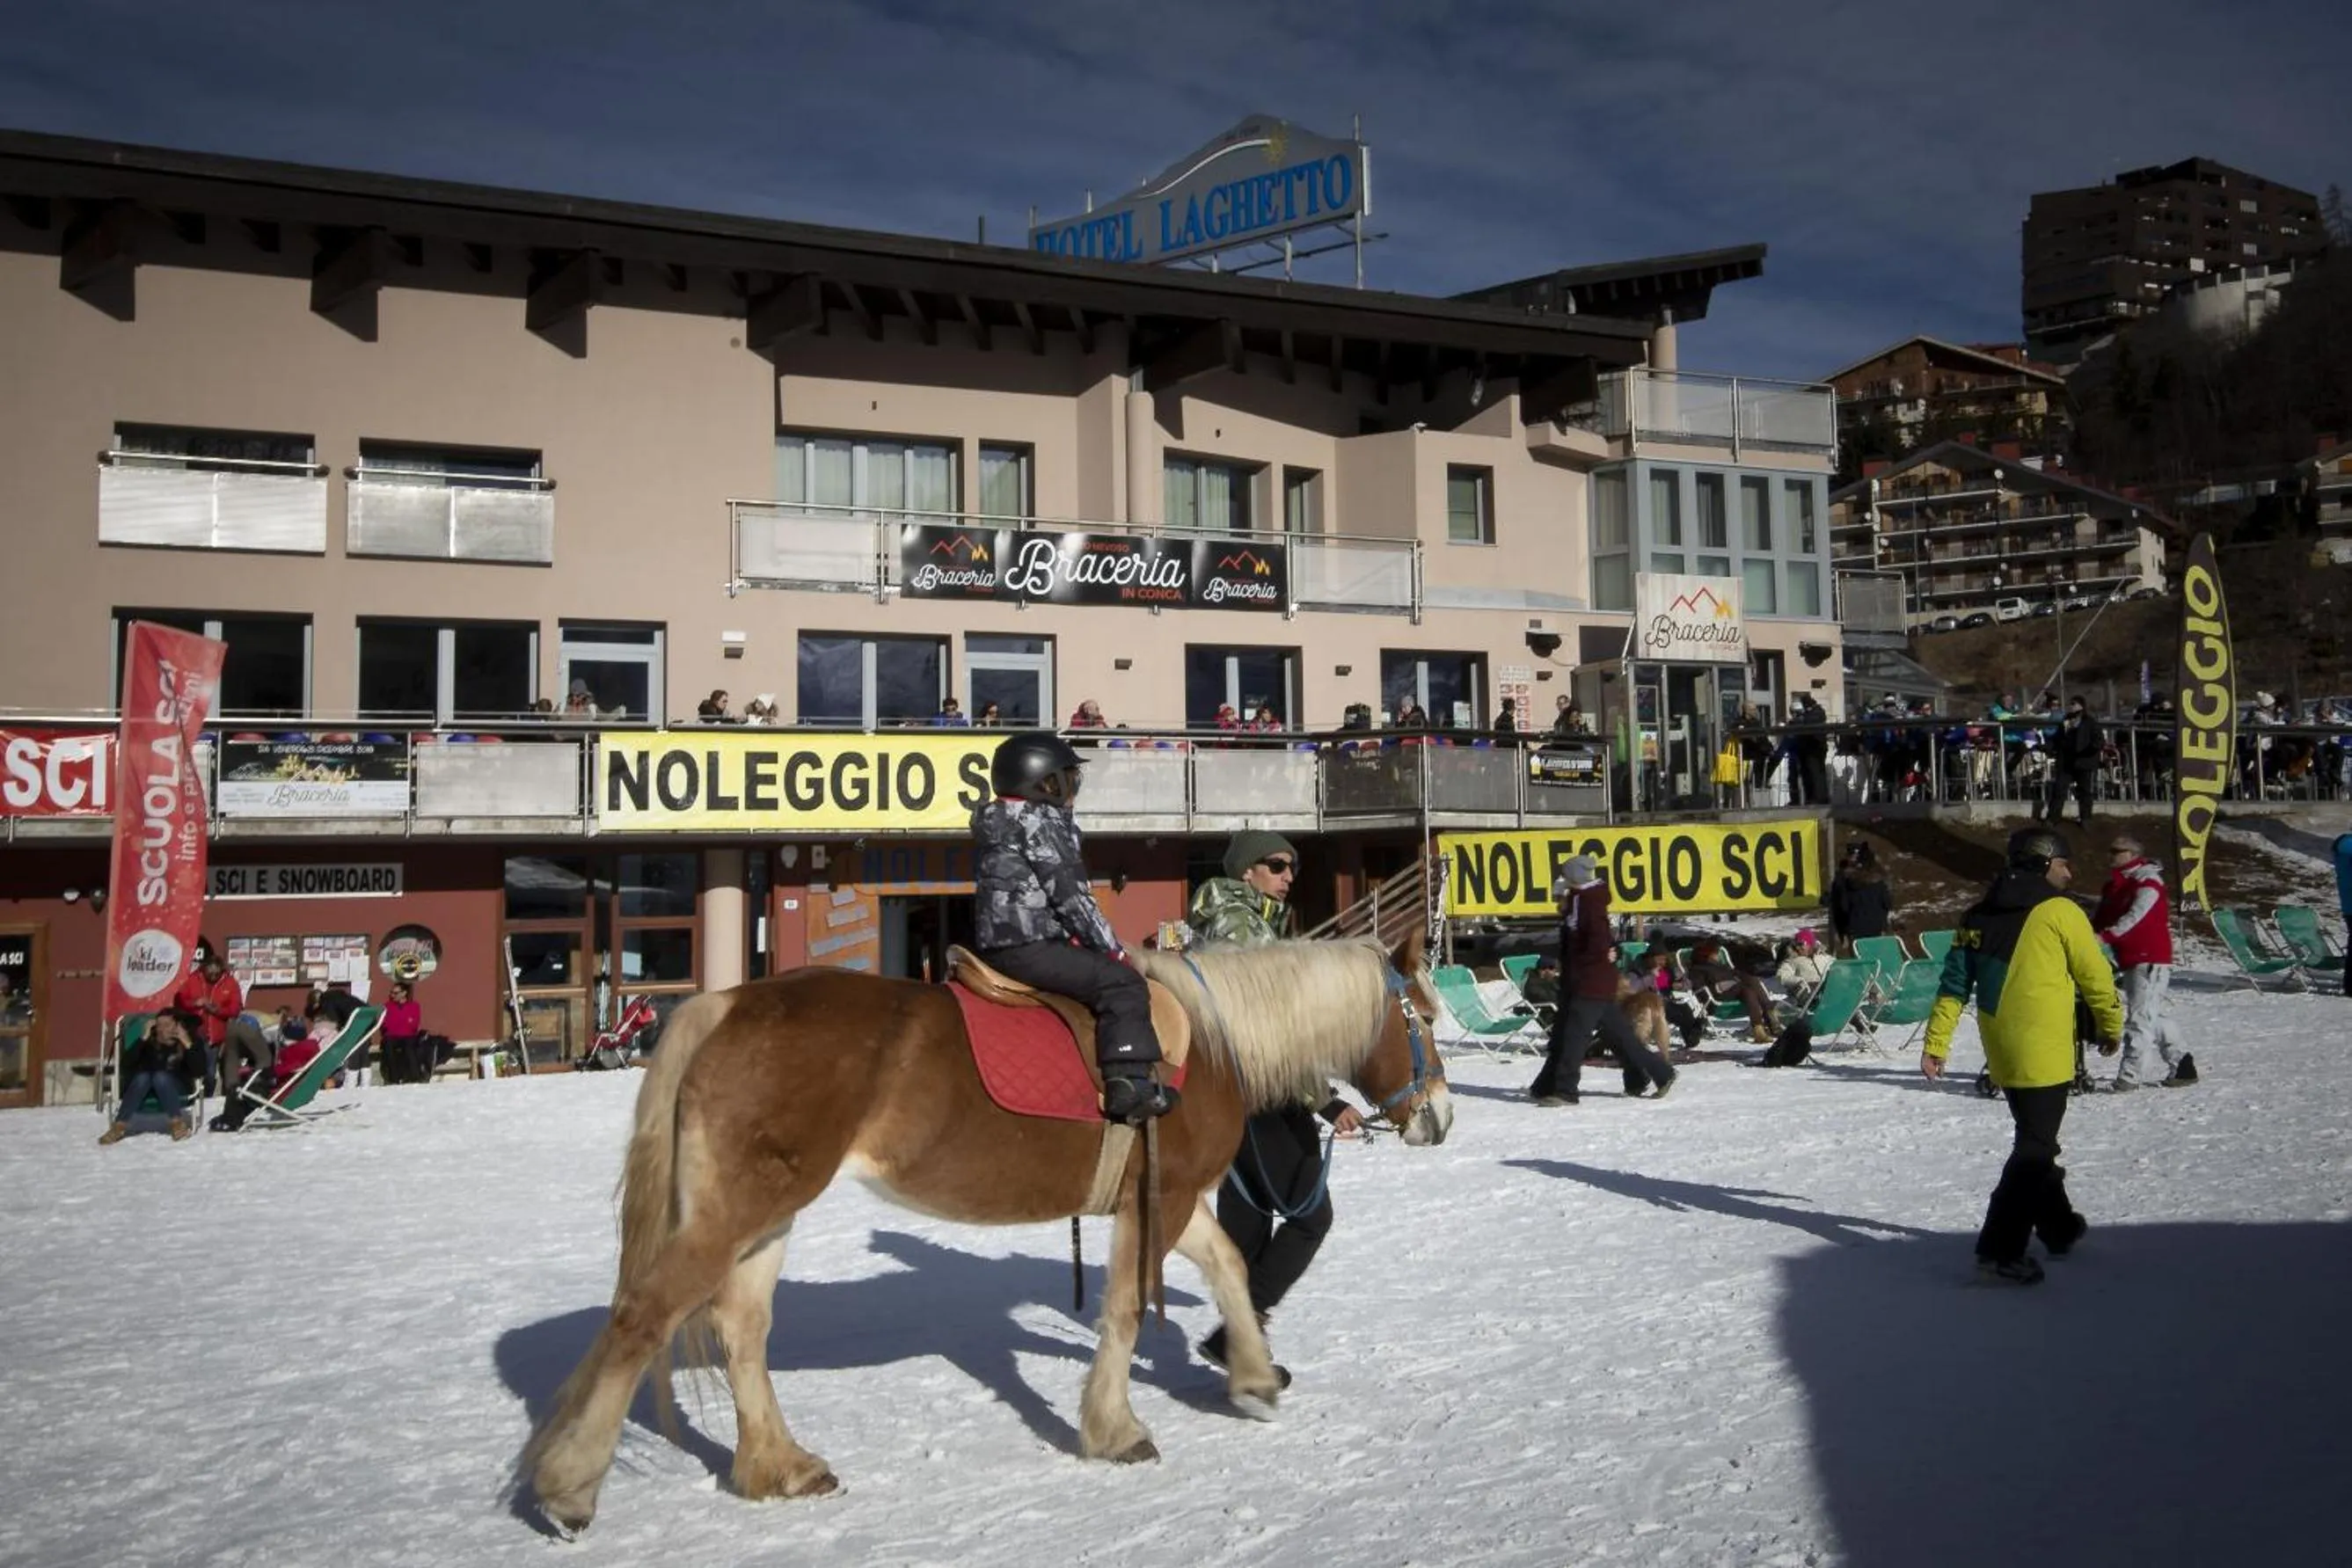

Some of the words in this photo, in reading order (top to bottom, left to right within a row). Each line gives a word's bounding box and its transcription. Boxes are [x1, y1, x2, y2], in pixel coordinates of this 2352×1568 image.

[1159, 154, 1353, 252] LAGHETTO
[911, 564, 996, 590] Braceria
[1004, 537, 1186, 595] Braceria
[1121, 587, 1135, 599] IN
[1137, 588, 1183, 602] CONCA
[1202, 577, 1277, 602] Braceria
[1644, 614, 1741, 649] Braceria
[2180, 565, 2230, 894] NOLEGGIO
[3, 737, 107, 809] SCI
[607, 749, 935, 812] NOLEGGIO
[268, 784, 352, 806] Braceria
[137, 733, 183, 907] SCUOLA
[175, 820, 199, 862] info
[215, 869, 245, 894] SCI
[256, 870, 268, 893] E
[277, 867, 396, 893] SNOWBOARD
[1721, 830, 1805, 901] SCI
[9, 952, 25, 966] SCI
